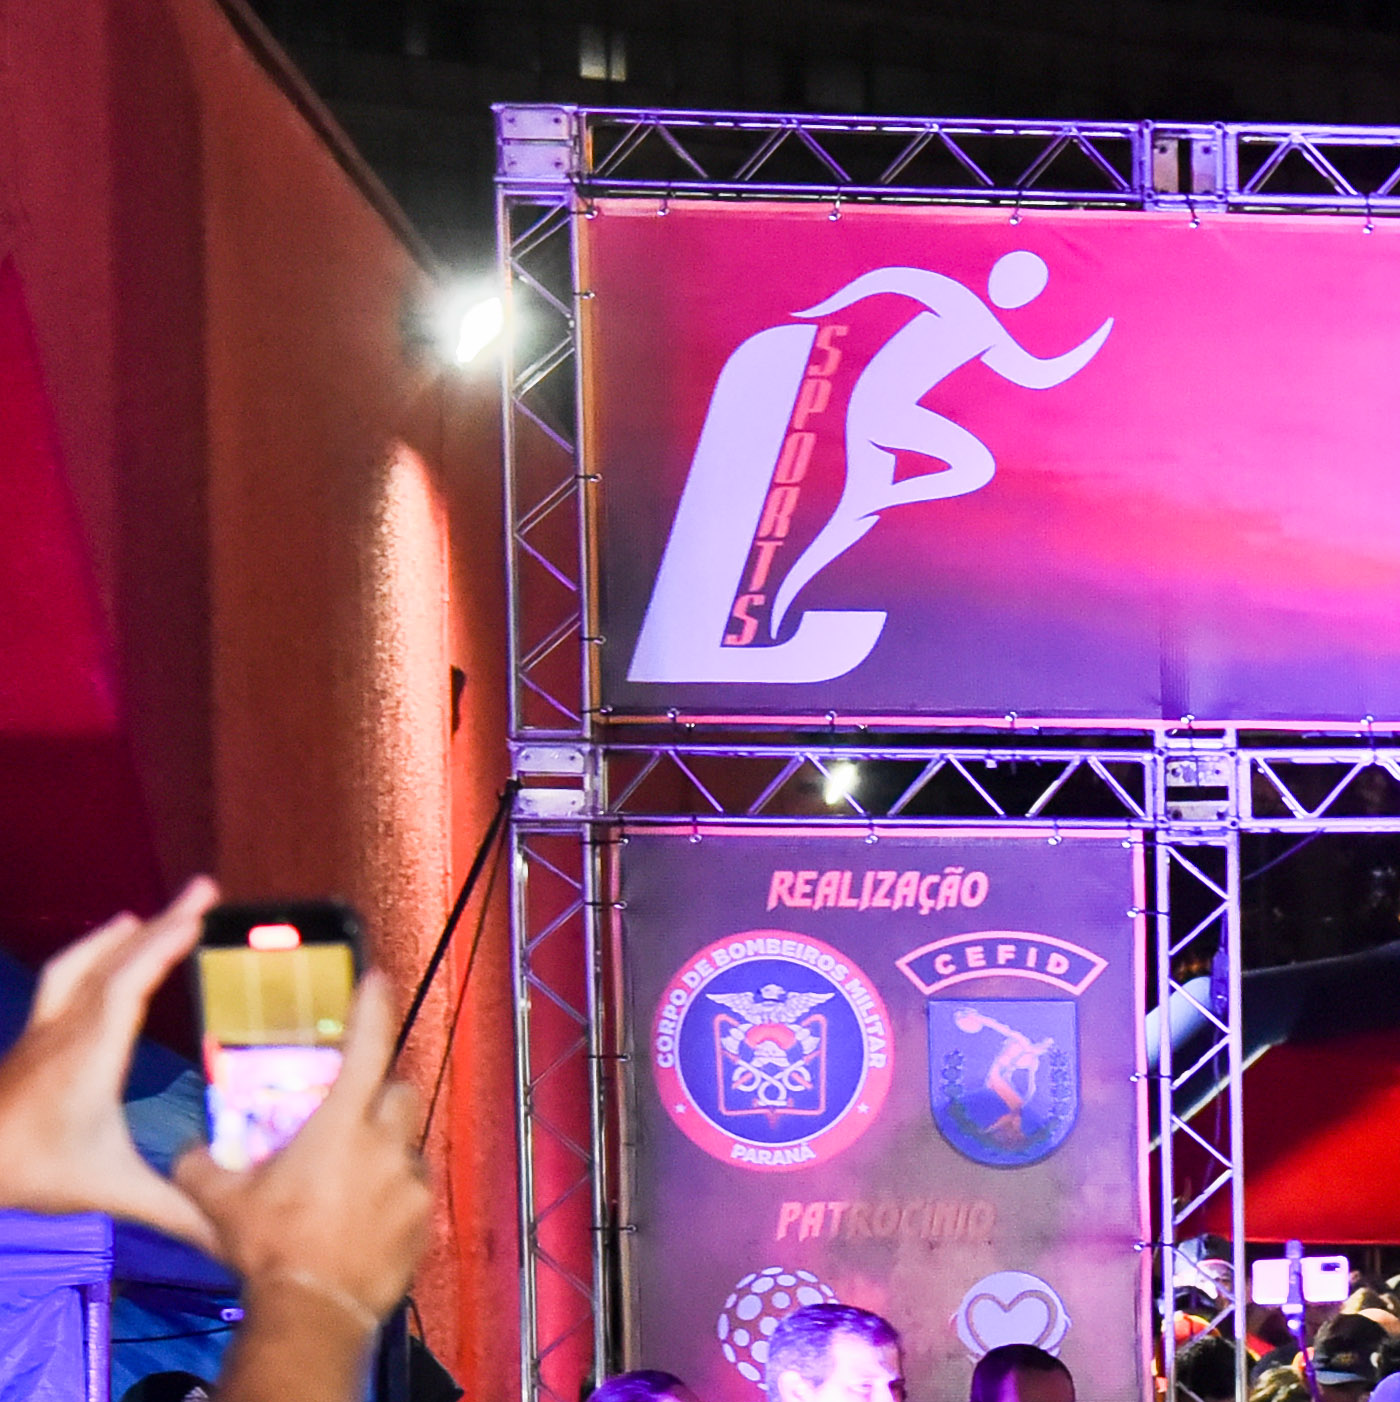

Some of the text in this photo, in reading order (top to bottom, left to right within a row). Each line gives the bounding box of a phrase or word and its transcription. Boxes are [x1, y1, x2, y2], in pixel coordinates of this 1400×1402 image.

[722, 324, 849, 646] SPORTS
[767, 866, 990, 915] REALIZAÇÃO
[936, 944, 1071, 976] CEFID
[656, 938, 888, 1069] CORPO DE BOMBEIROS MILITAR
[731, 1143, 816, 1165] PARANÁ
